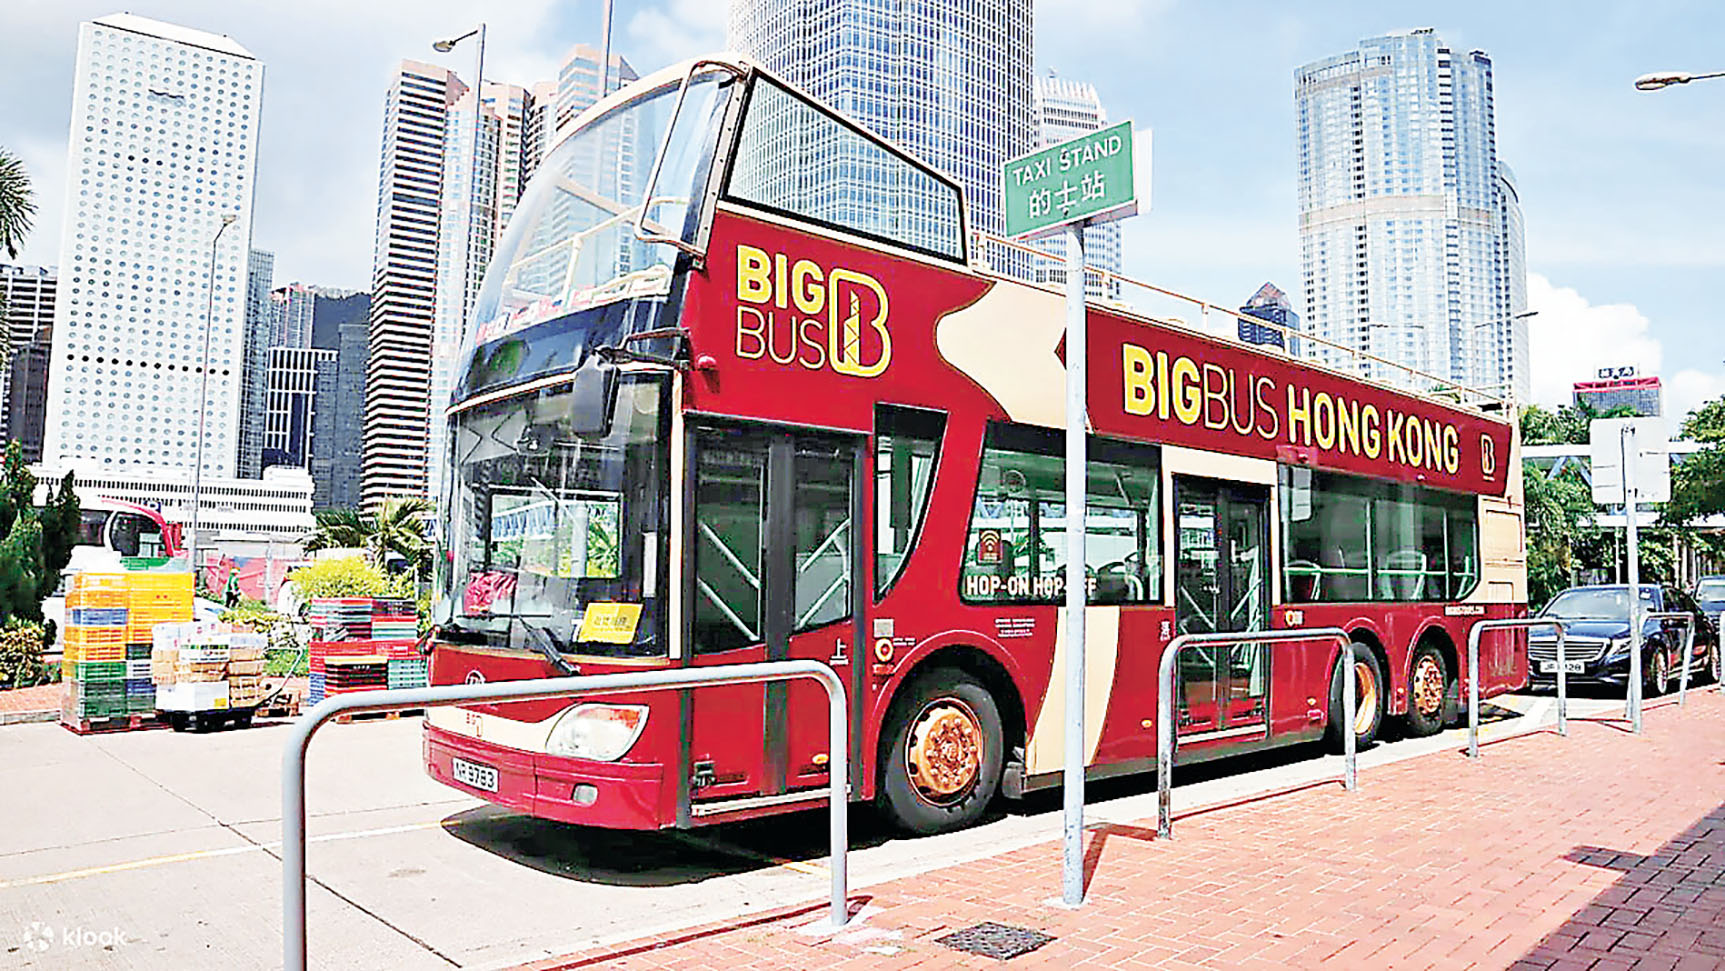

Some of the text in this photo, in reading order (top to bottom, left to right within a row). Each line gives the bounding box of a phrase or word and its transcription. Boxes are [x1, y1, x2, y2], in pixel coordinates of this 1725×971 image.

[1013, 135, 1122, 186] TAXI STAND
[1029, 170, 1105, 218] 的士站
[737, 244, 826, 315] BIG
[736, 305, 826, 369] BUS
[1287, 383, 1381, 459] HONG
[1387, 408, 1460, 474] KONG
[966, 575, 1030, 595] HOP-ON
